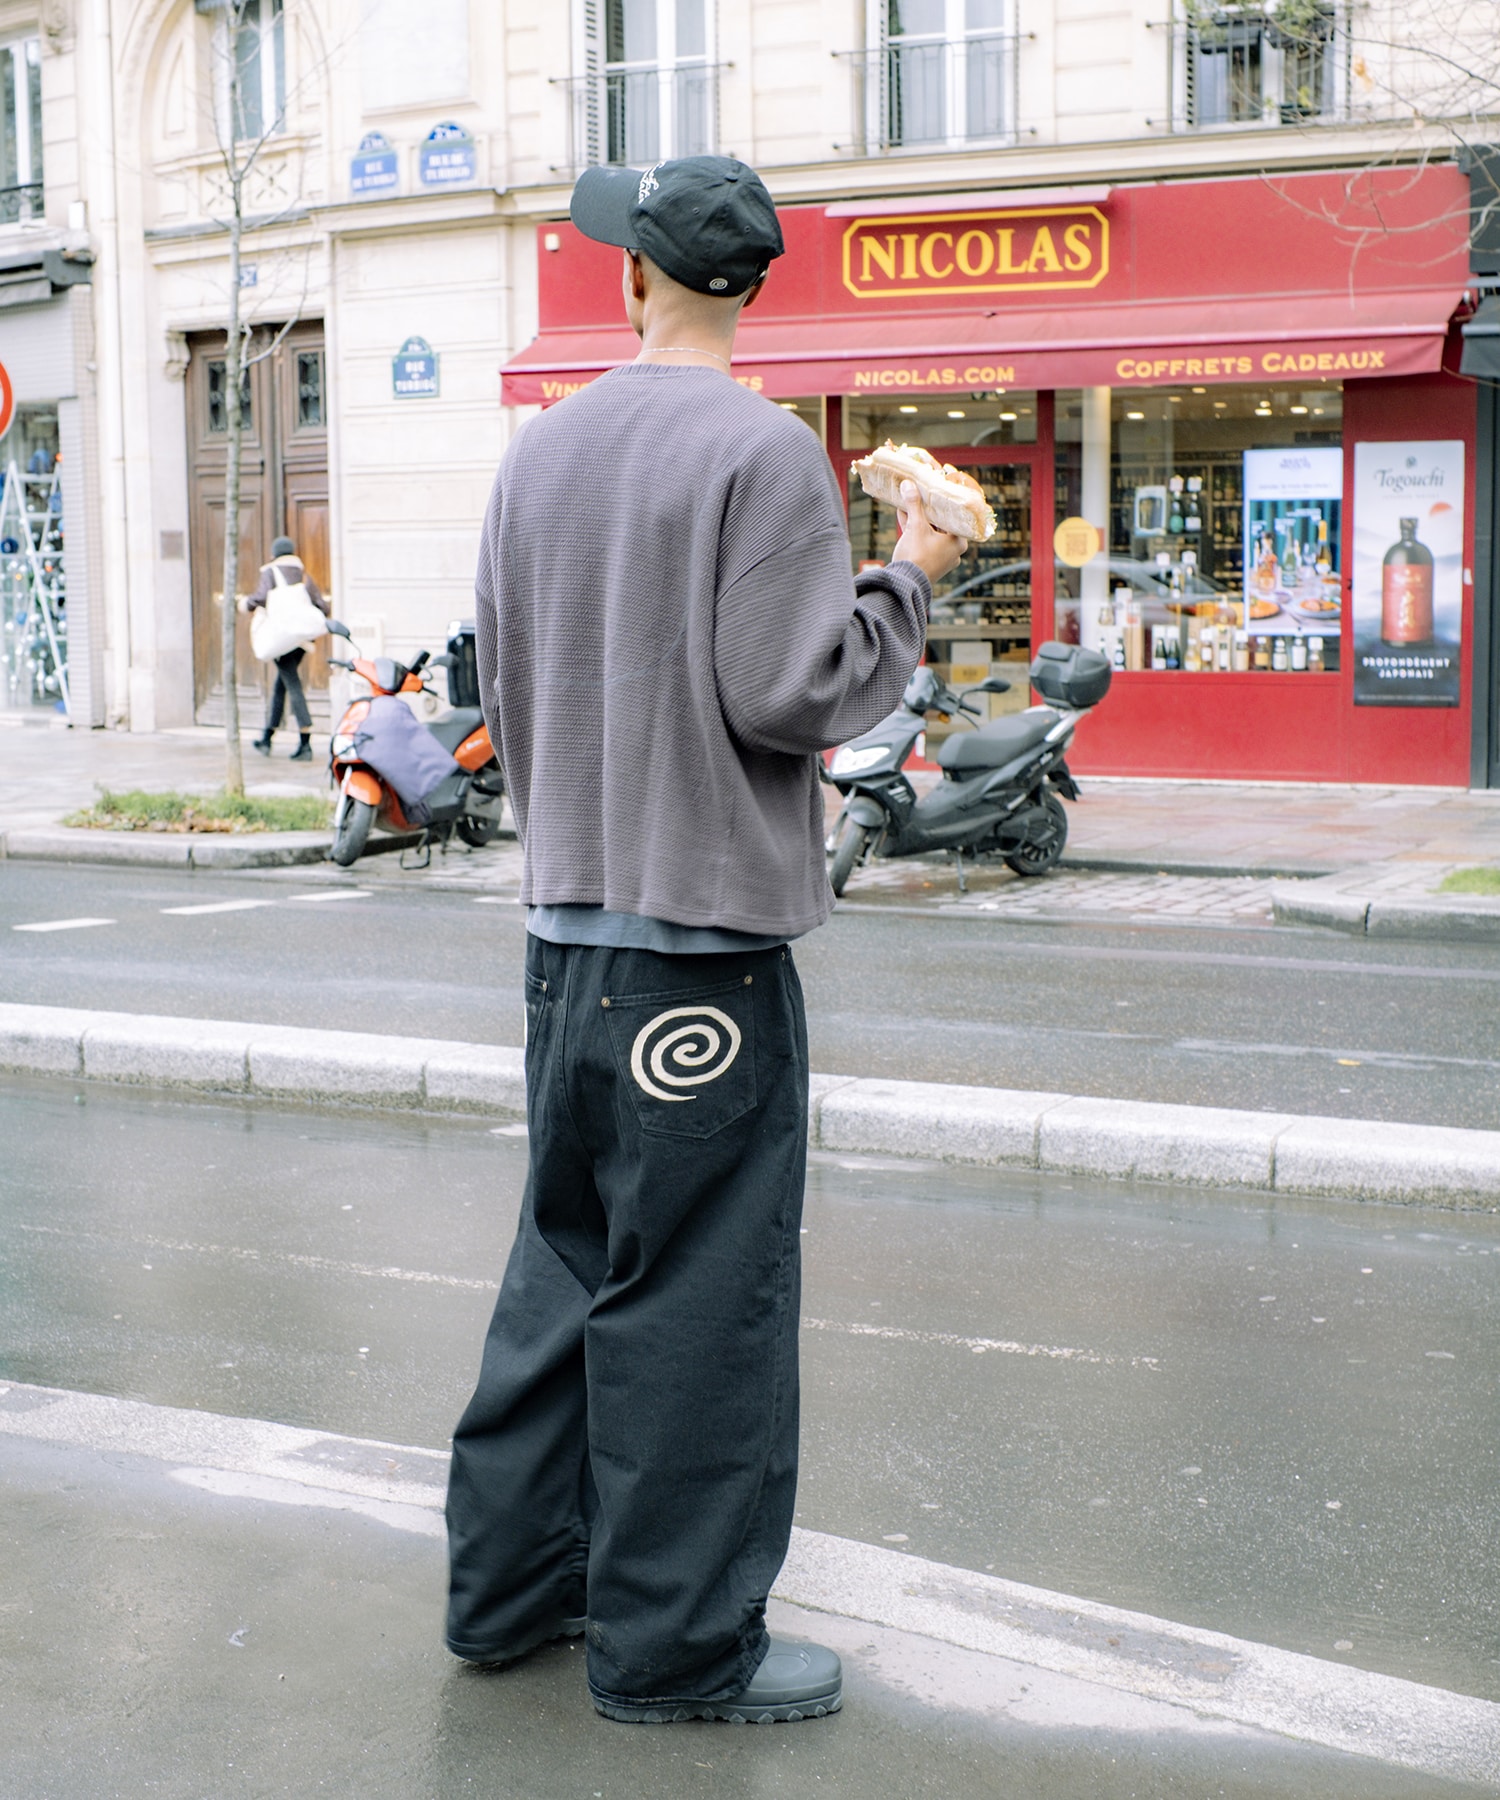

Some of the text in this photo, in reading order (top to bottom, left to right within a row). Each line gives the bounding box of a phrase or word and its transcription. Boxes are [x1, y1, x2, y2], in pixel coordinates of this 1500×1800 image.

[859, 223, 1093, 282] NICOLAS
[854, 366, 1015, 387] NICOLAS.COM
[1115, 351, 1386, 379] COFFRETS CADEAUX
[1374, 467, 1445, 493] Togouchi
[1378, 669, 1434, 679] JAPONAIS
